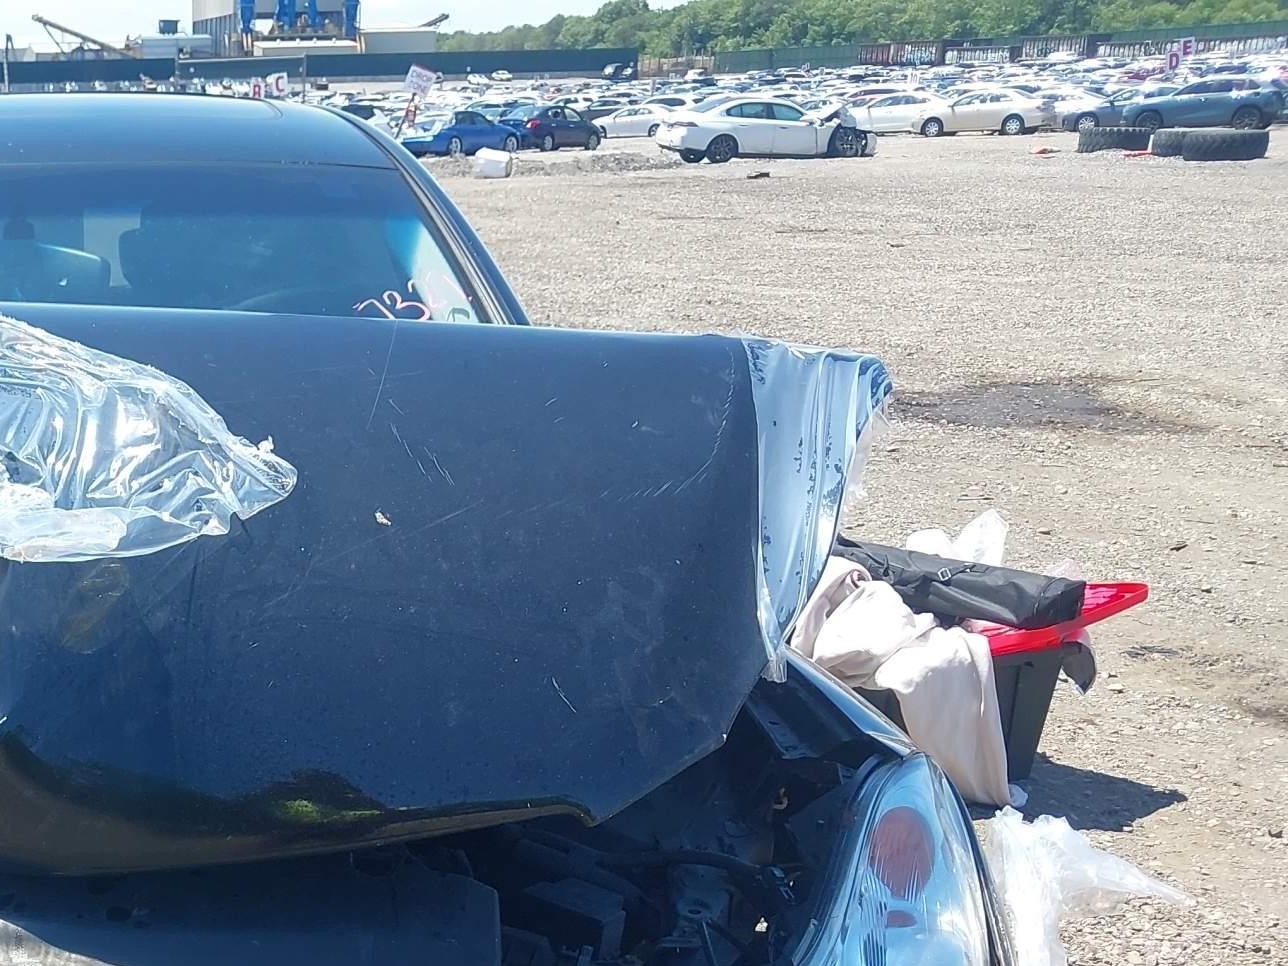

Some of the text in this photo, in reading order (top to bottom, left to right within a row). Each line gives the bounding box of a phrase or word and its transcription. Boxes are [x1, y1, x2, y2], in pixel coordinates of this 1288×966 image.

[1183, 40, 1192, 55] E
[1169, 53, 1179, 70] D
[275, 76, 285, 93] C
